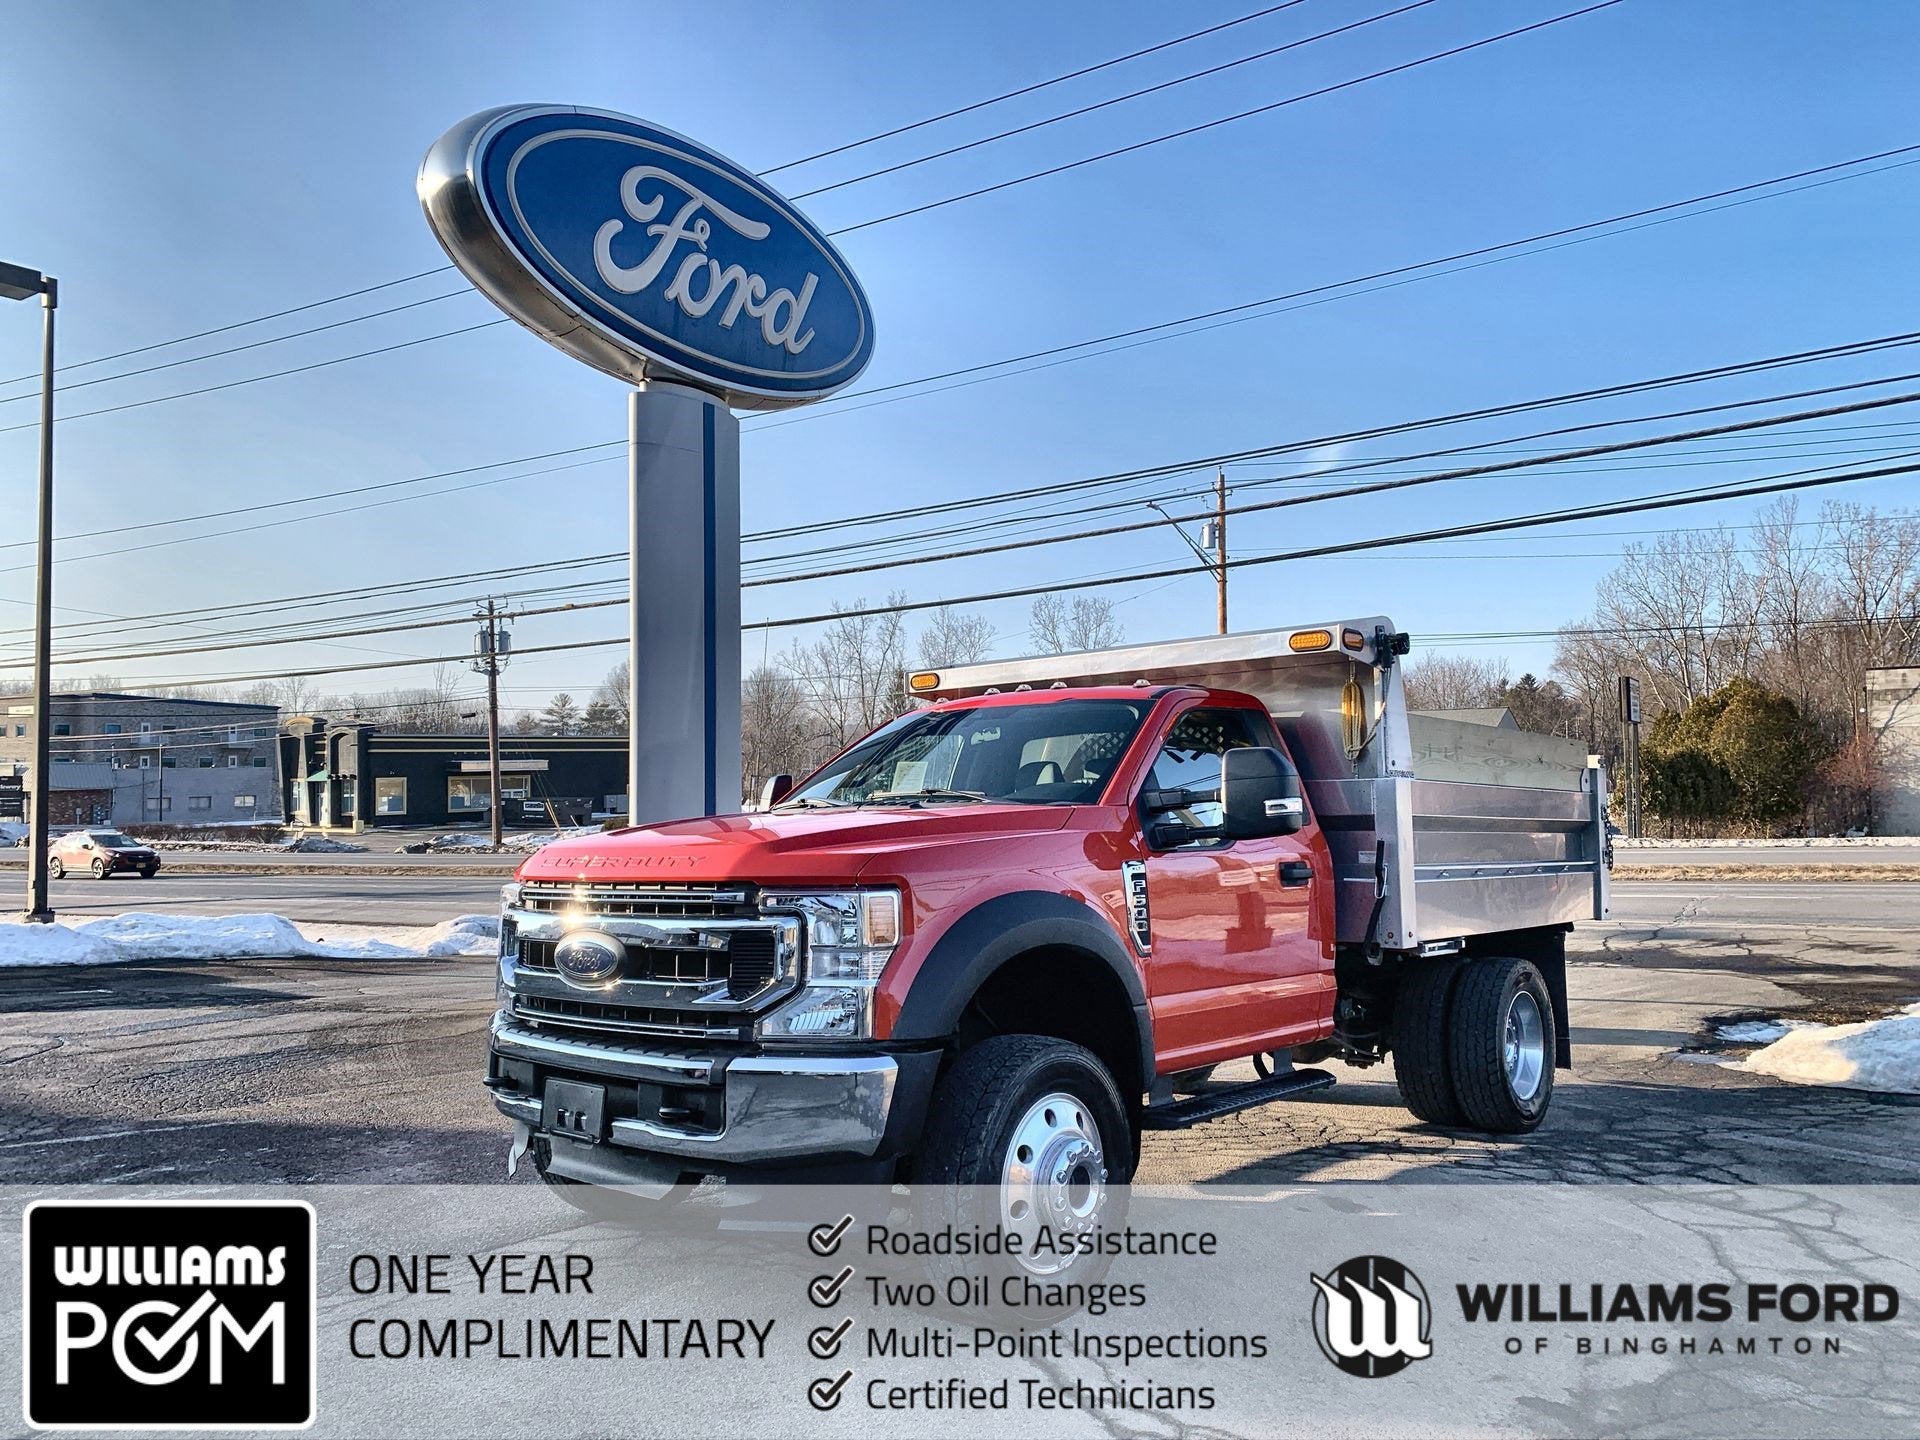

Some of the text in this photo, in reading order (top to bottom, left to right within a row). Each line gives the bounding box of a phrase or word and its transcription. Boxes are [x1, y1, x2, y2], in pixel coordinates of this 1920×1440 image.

[594, 166, 819, 354] Ford
[541, 856, 708, 868] SUPER DUTY
[567, 945, 601, 970] Ford
